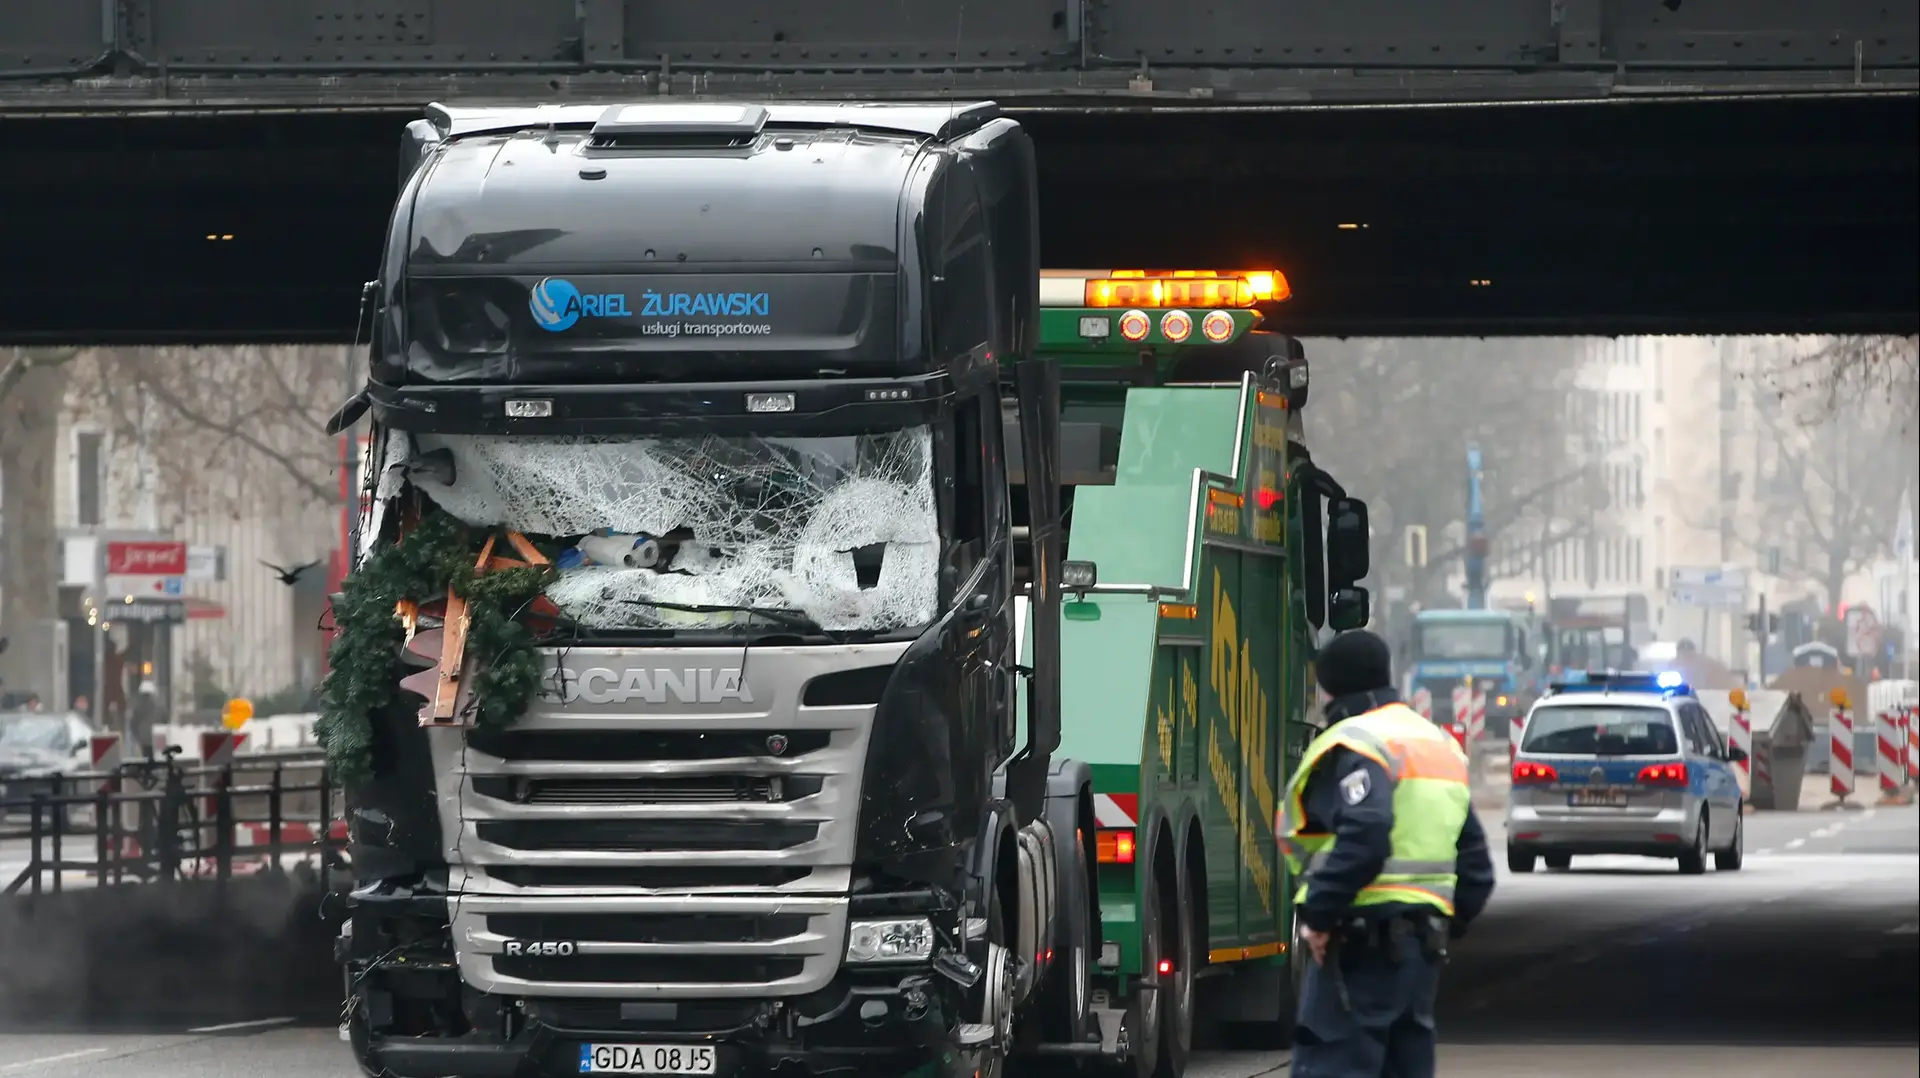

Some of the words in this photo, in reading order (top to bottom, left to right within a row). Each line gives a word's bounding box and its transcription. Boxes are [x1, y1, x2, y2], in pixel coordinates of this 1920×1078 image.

[564, 294, 632, 316] ARIEL
[642, 289, 769, 316] ŻURAWSKI
[642, 322, 680, 337] usługi
[684, 322, 771, 337] transportowe
[541, 667, 754, 703] SCANIA
[506, 941, 523, 956] R
[527, 941, 574, 956] 450
[595, 1046, 645, 1070] GDA
[654, 1047, 711, 1071] 08J5
